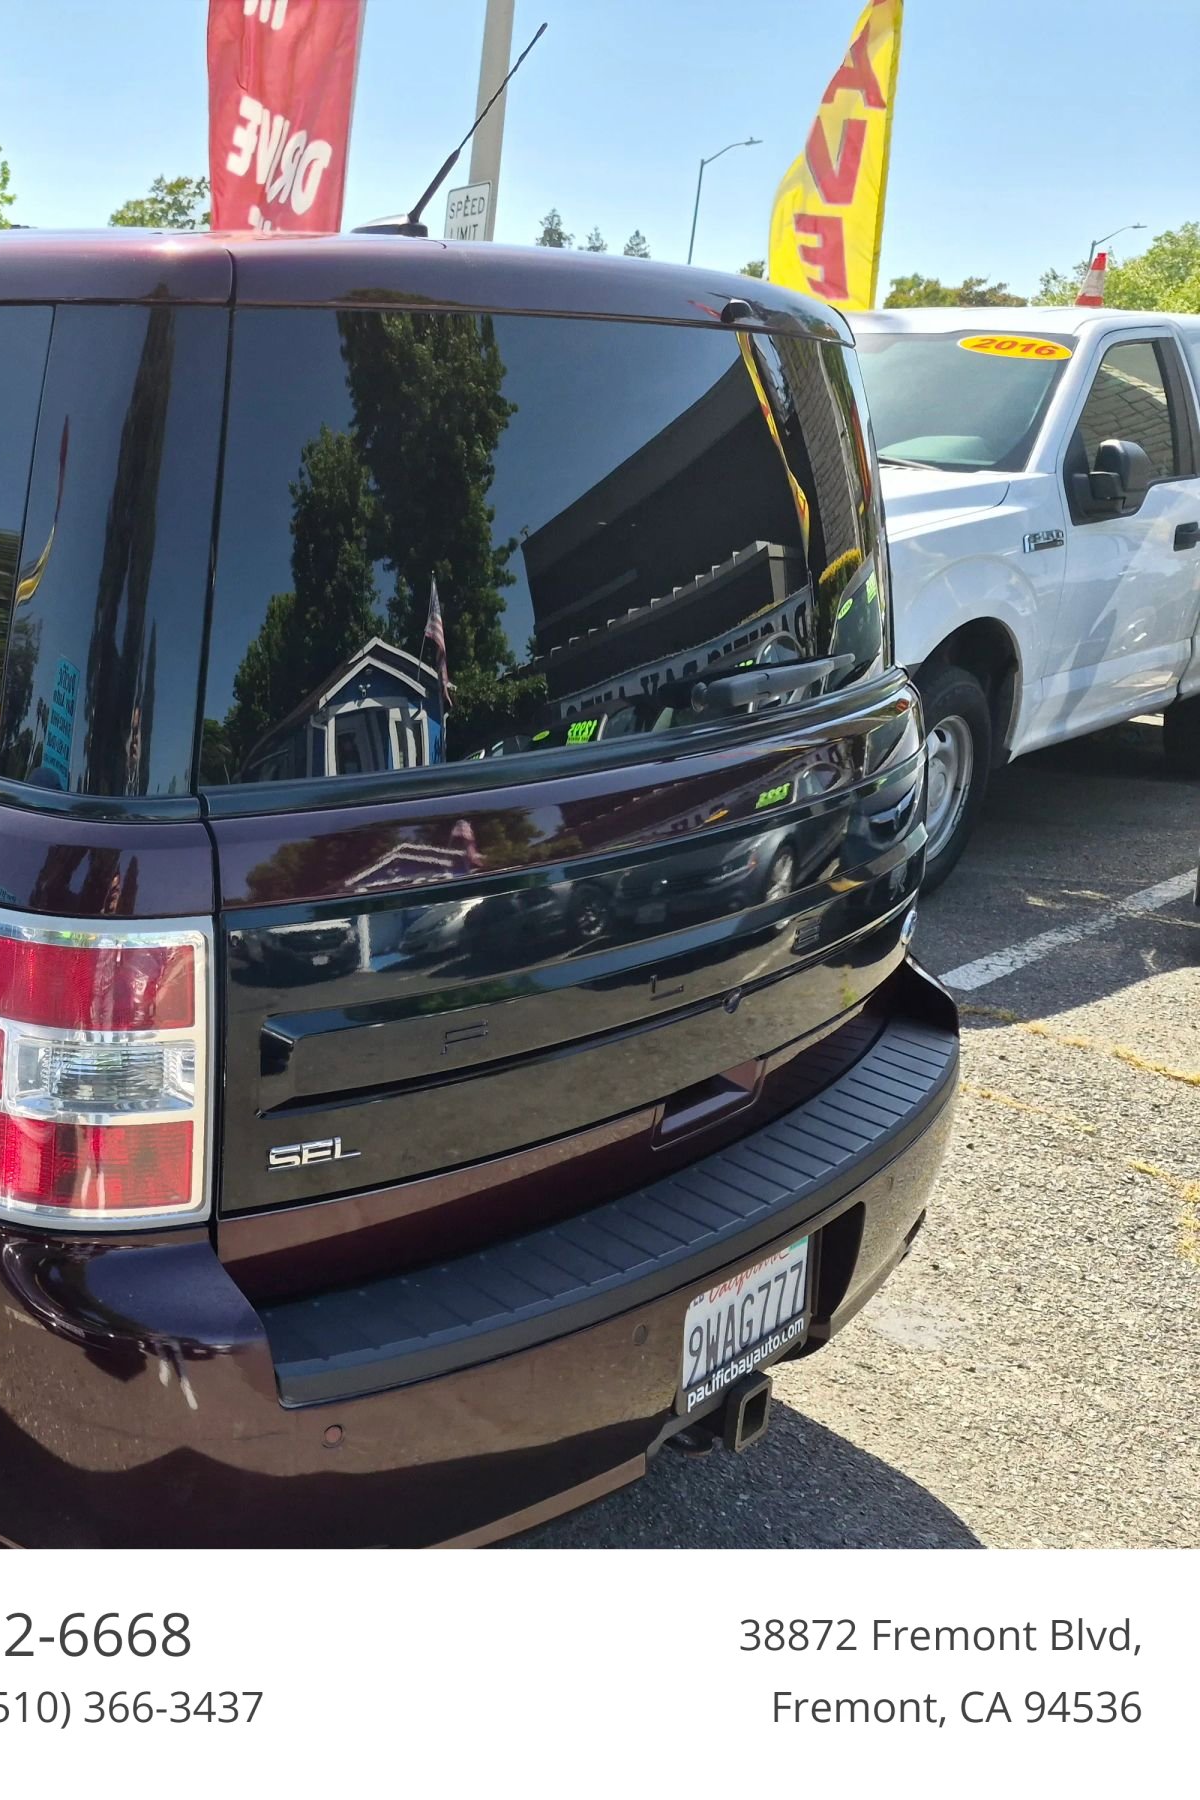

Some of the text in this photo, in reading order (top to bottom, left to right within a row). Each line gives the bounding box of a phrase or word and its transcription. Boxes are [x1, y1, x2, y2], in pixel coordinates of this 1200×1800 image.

[449, 196, 485, 219] SPEED
[971, 338, 1059, 356] 2016
[267, 1137, 361, 1171] SEL
[687, 1260, 803, 1386] 9WAG777
[687, 1318, 804, 1414] pacificbayauto.com
